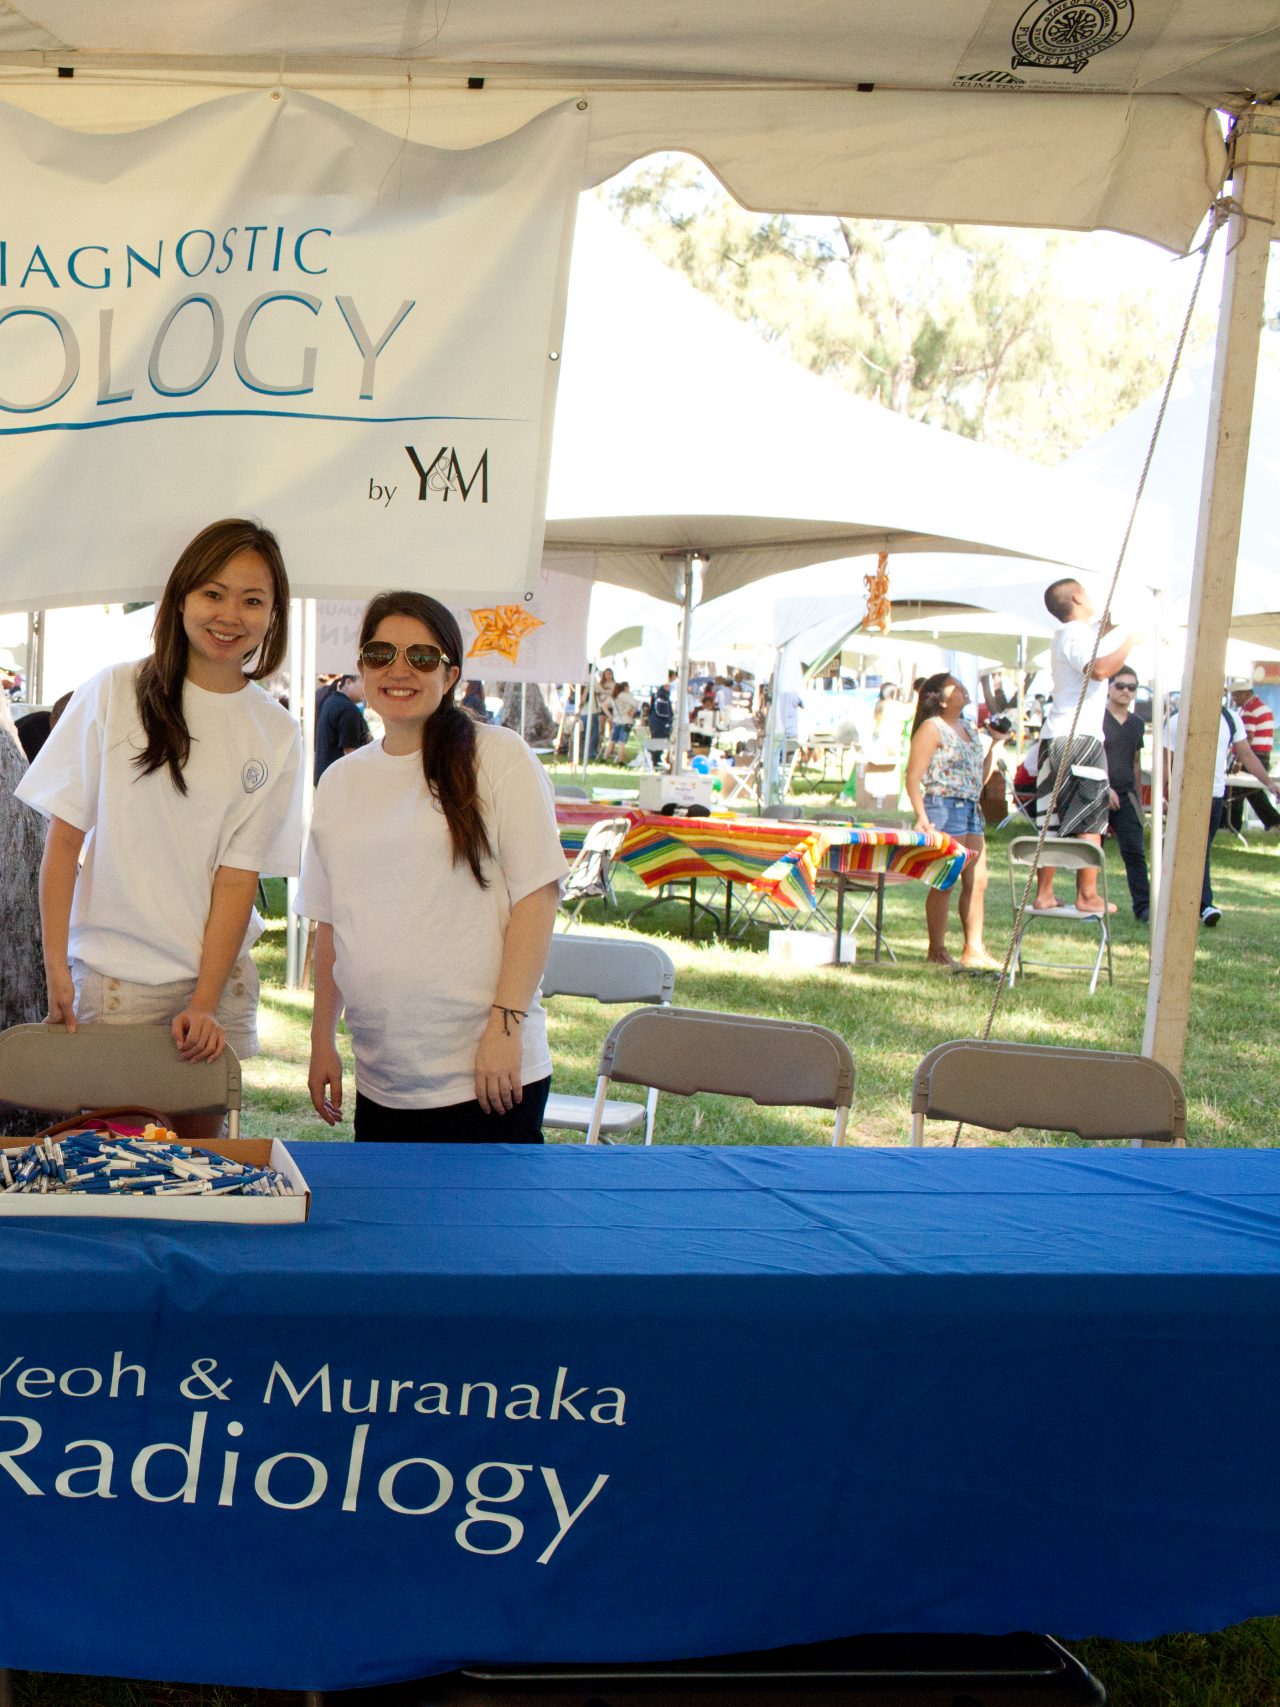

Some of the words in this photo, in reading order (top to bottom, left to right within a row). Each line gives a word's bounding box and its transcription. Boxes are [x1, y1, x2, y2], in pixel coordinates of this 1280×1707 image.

[1044, 2, 1068, 22] STATE
[1017, 25, 1036, 59] FLAME
[1034, 31, 1122, 65] RETARDANT
[952, 81, 992, 90] CELINA
[368, 477, 398, 508] by
[404, 445, 489, 503] Y&M
[179, 1357, 234, 1401] &
[263, 1359, 627, 1427] Muranaka
